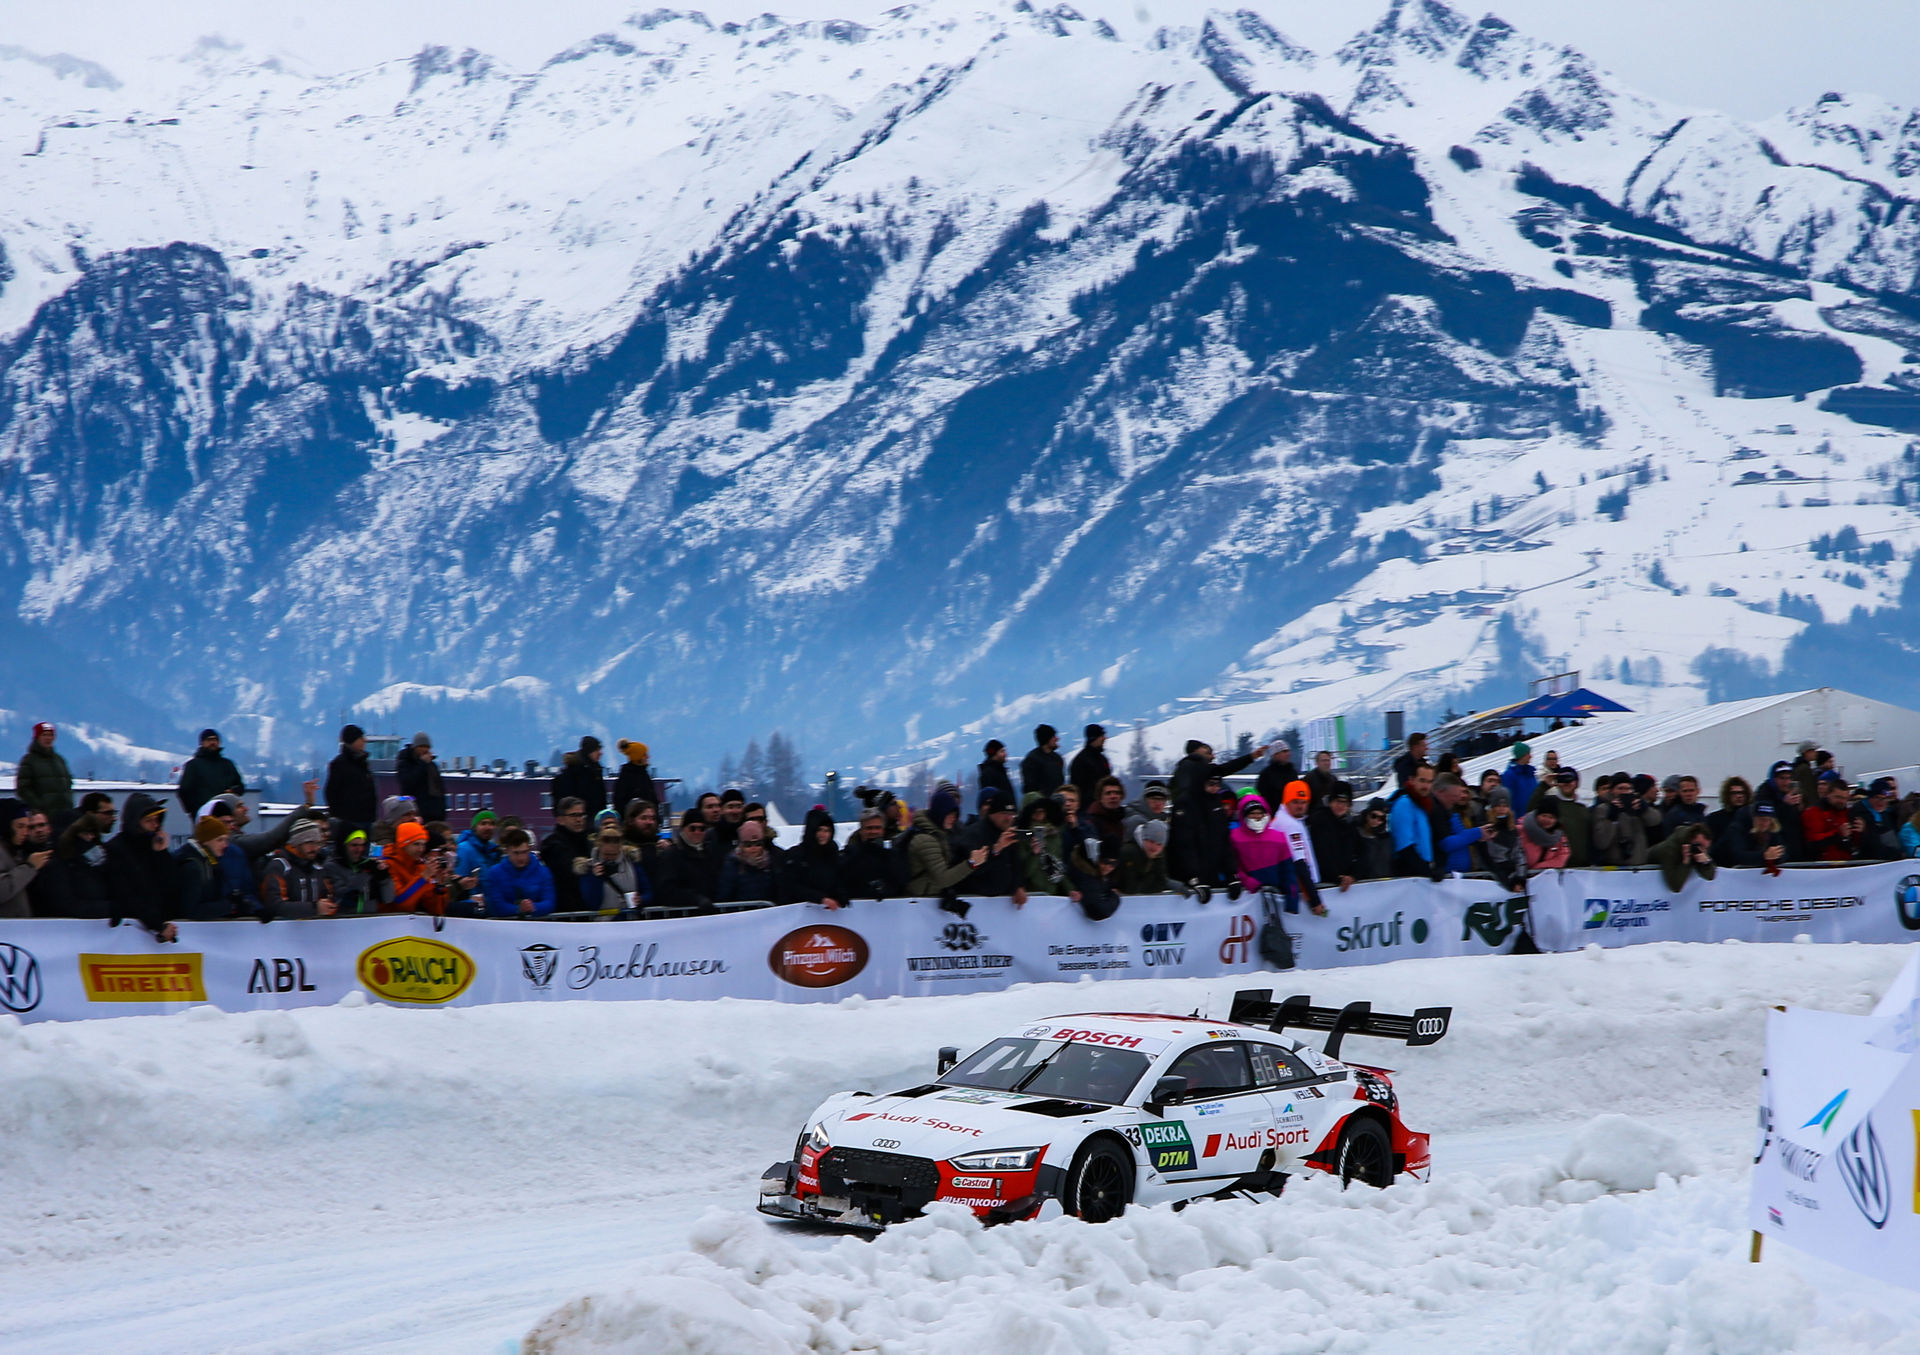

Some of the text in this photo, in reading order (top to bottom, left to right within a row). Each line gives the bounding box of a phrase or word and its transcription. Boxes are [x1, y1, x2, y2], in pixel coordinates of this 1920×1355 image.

[1699, 896, 1865, 912] PORSCHE DESIGN
[1336, 911, 1403, 952] skruf
[1066, 944, 1101, 957] Energie
[1142, 947, 1186, 967] OMV
[88, 963, 194, 993] PIRELLI
[247, 958, 317, 993] ABL
[388, 956, 458, 985] RAUCH
[1051, 1028, 1144, 1048] BOSCH
[872, 1113, 984, 1137] Audi Sport
[1145, 1125, 1187, 1144] DEKRA
[1125, 1127, 1141, 1147] 33
[1225, 1128, 1309, 1151] Audi Sport
[1158, 1151, 1189, 1167] DTM
[961, 1178, 991, 1187] Castrol
